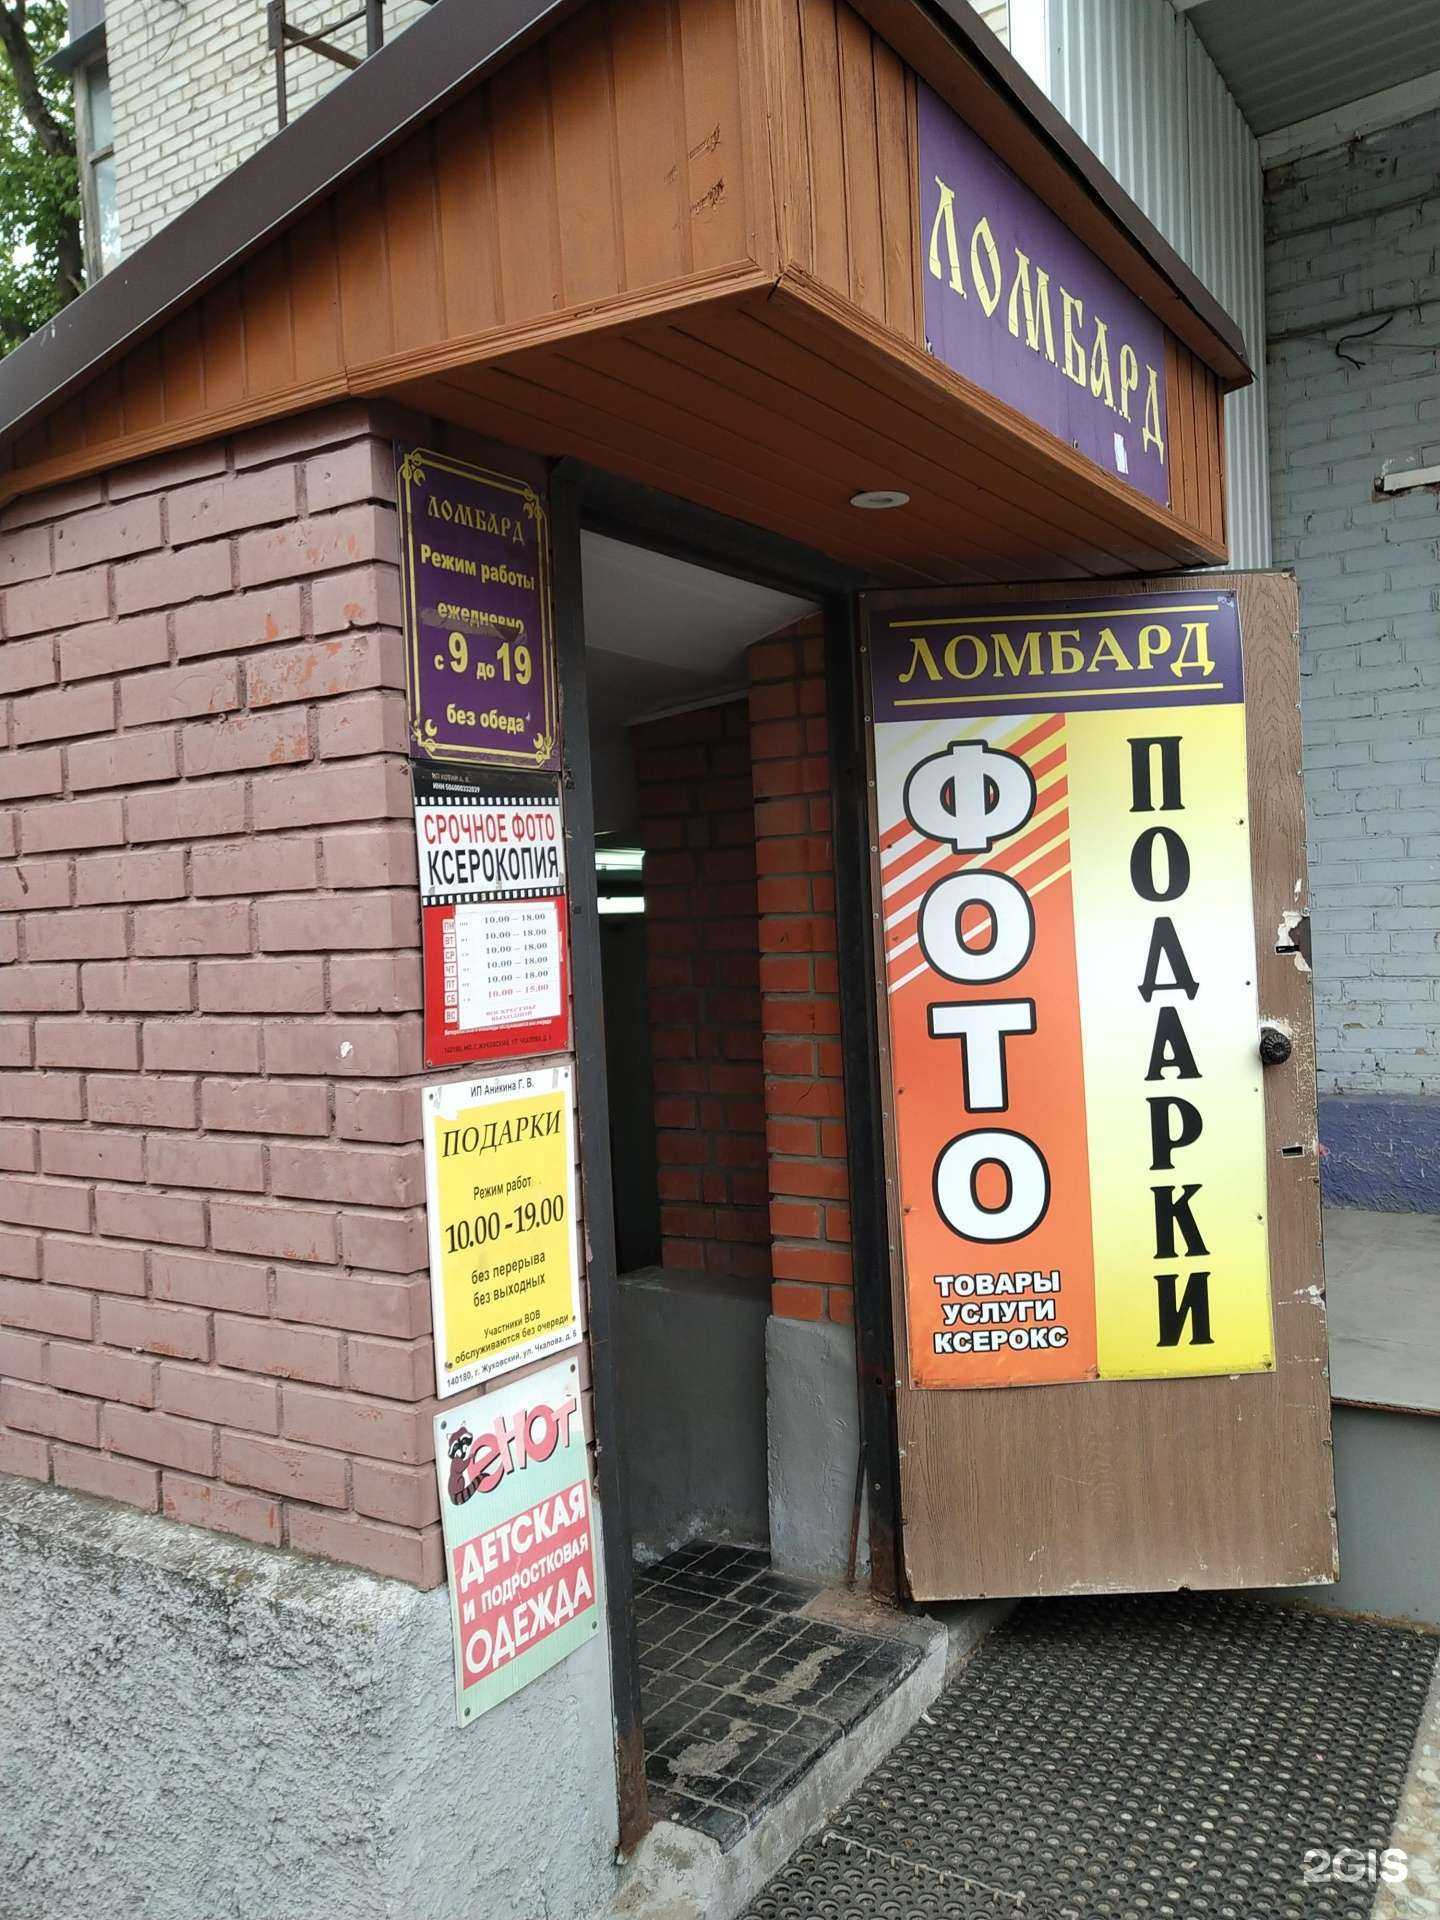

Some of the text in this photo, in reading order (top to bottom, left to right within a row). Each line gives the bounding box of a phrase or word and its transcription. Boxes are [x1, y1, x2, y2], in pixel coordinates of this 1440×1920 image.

[929, 175, 1164, 464] ЛОМБАРД
[428, 495, 525, 546] ЛОМБАРД
[421, 544, 535, 590] Режим работы
[434, 632, 532, 685] с 9 до 19
[898, 622, 1216, 684] ЛОМБАРД
[447, 703, 525, 734] без обеда
[425, 813, 555, 844] СРОЧНОЕ ФОТО
[428, 846, 559, 885] КСЕРОКОПИЯ
[902, 739, 1051, 1244] ФОТО
[1127, 735, 1213, 1346] ПОДАРКИ
[470, 1085, 482, 1097] ИП
[442, 1110, 561, 1157] ПОДАРКИ
[474, 1183, 503, 1200] Режим
[471, 1252, 545, 1285] без перерыва
[473, 1273, 546, 1307] без выходных
[934, 1270, 1061, 1297] ТОВАРЫ
[484, 1310, 541, 1338] Участники ВОВ
[942, 1299, 1056, 1326] УСЛУГИ
[455, 1314, 569, 1364] обслуживаются без очереди
[934, 1325, 1068, 1354] КСЕРОКС
[460, 1484, 587, 1593] ДЕТСКАЯ
[481, 1532, 589, 1614] ПОДРОСТКОВАЯ
[465, 1566, 592, 1674] ОДЕЖДА
